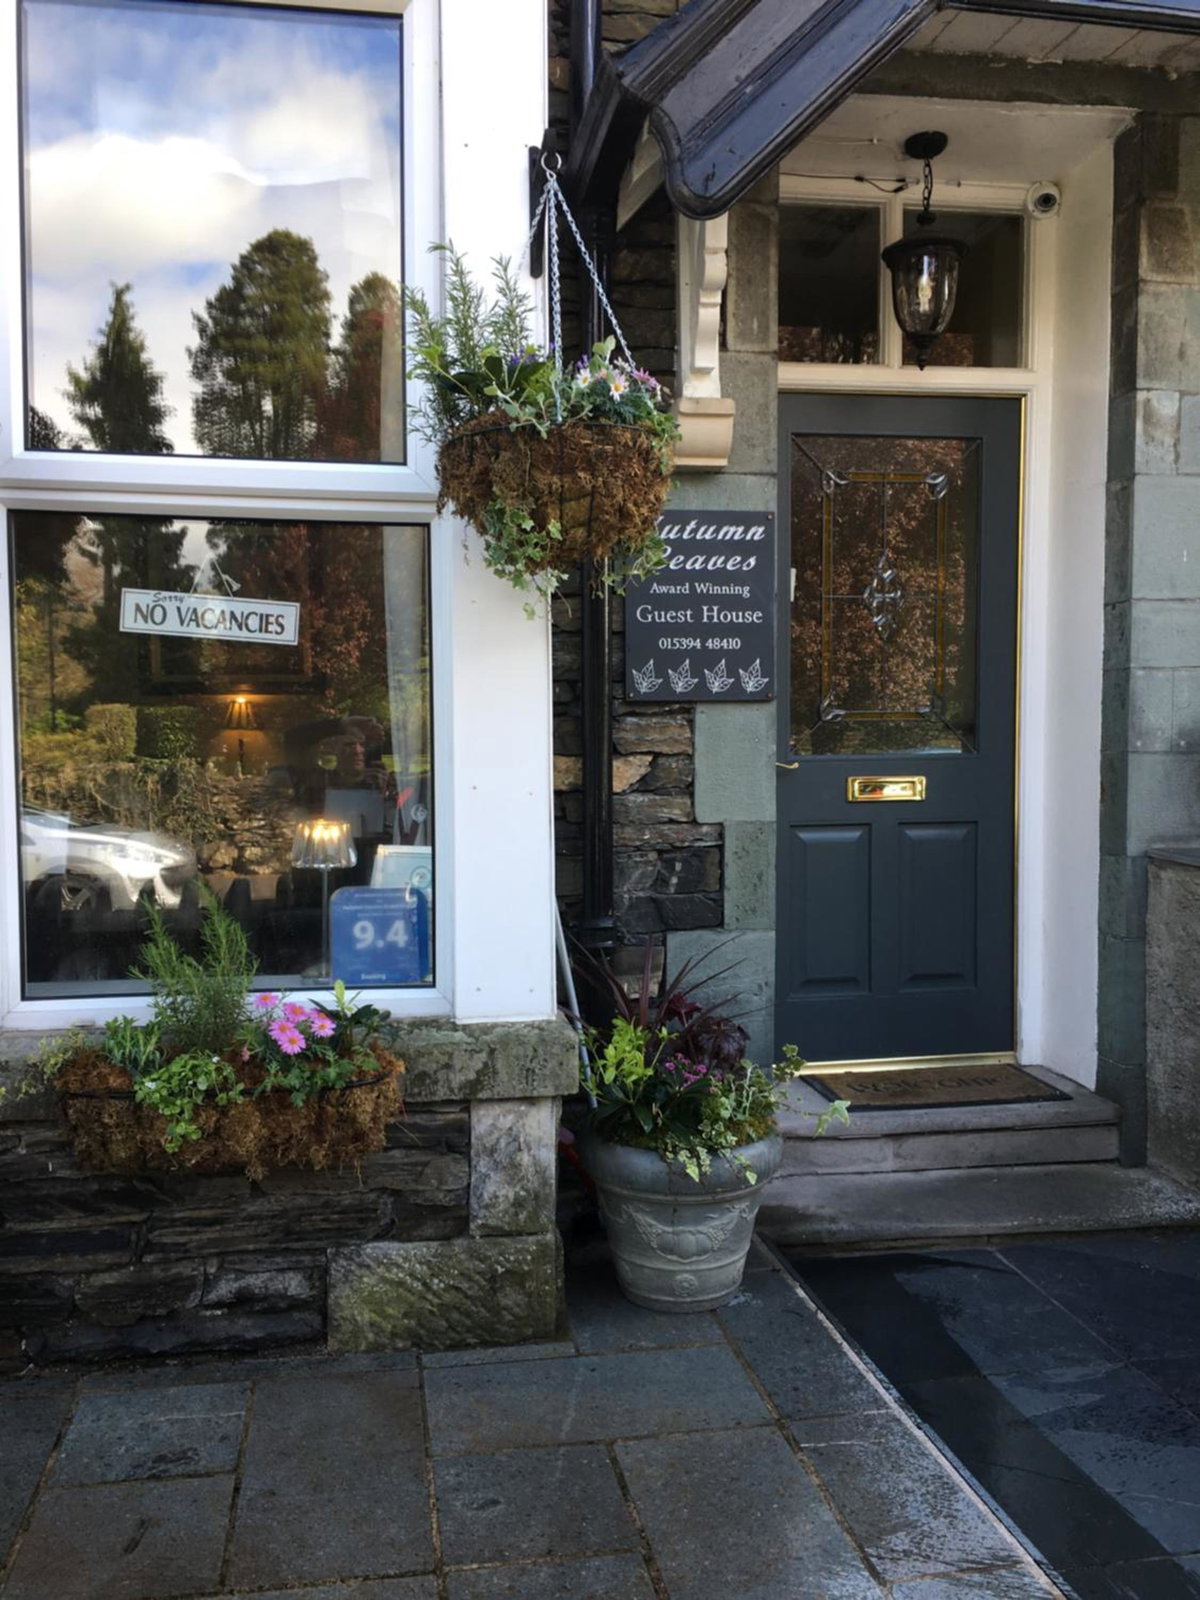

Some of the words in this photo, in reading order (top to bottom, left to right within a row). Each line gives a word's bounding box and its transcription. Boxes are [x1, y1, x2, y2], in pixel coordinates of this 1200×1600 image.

[655, 516, 764, 540] utumn
[152, 592, 185, 604] Sorry
[650, 582, 689, 594] Award
[695, 582, 750, 598] Winning
[134, 603, 167, 625] NO
[176, 606, 285, 635] VACANCIES
[636, 605, 694, 623] Guest
[702, 605, 763, 623] House
[659, 637, 701, 649] 015394
[705, 637, 741, 649] 48410
[353, 920, 408, 950] 9.4
